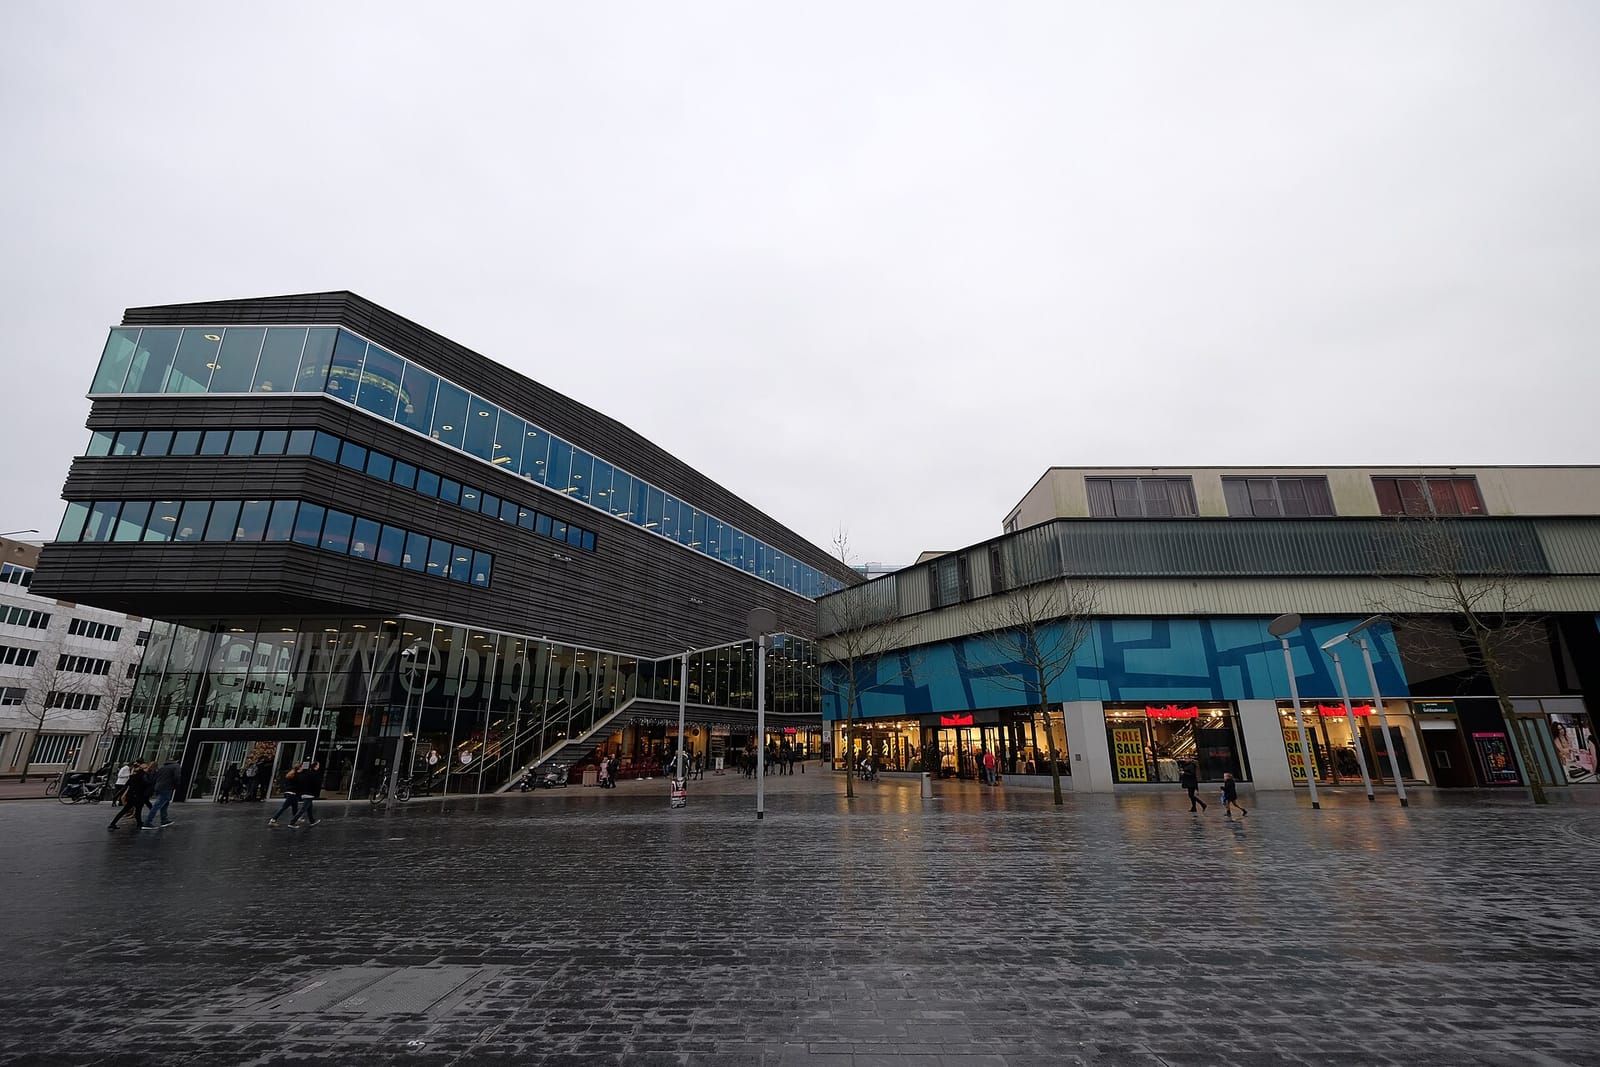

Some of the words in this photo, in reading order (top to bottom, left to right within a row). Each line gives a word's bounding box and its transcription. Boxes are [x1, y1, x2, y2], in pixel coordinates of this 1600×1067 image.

[1115, 731, 1140, 742] SALE
[1284, 730, 1309, 741] SAE
[1116, 743, 1141, 754] SALE
[1287, 742, 1312, 753] SAE
[1118, 755, 1143, 766] SALE
[1289, 754, 1315, 765] SAE
[1120, 767, 1145, 779] SALE
[1292, 767, 1318, 778] SAE
